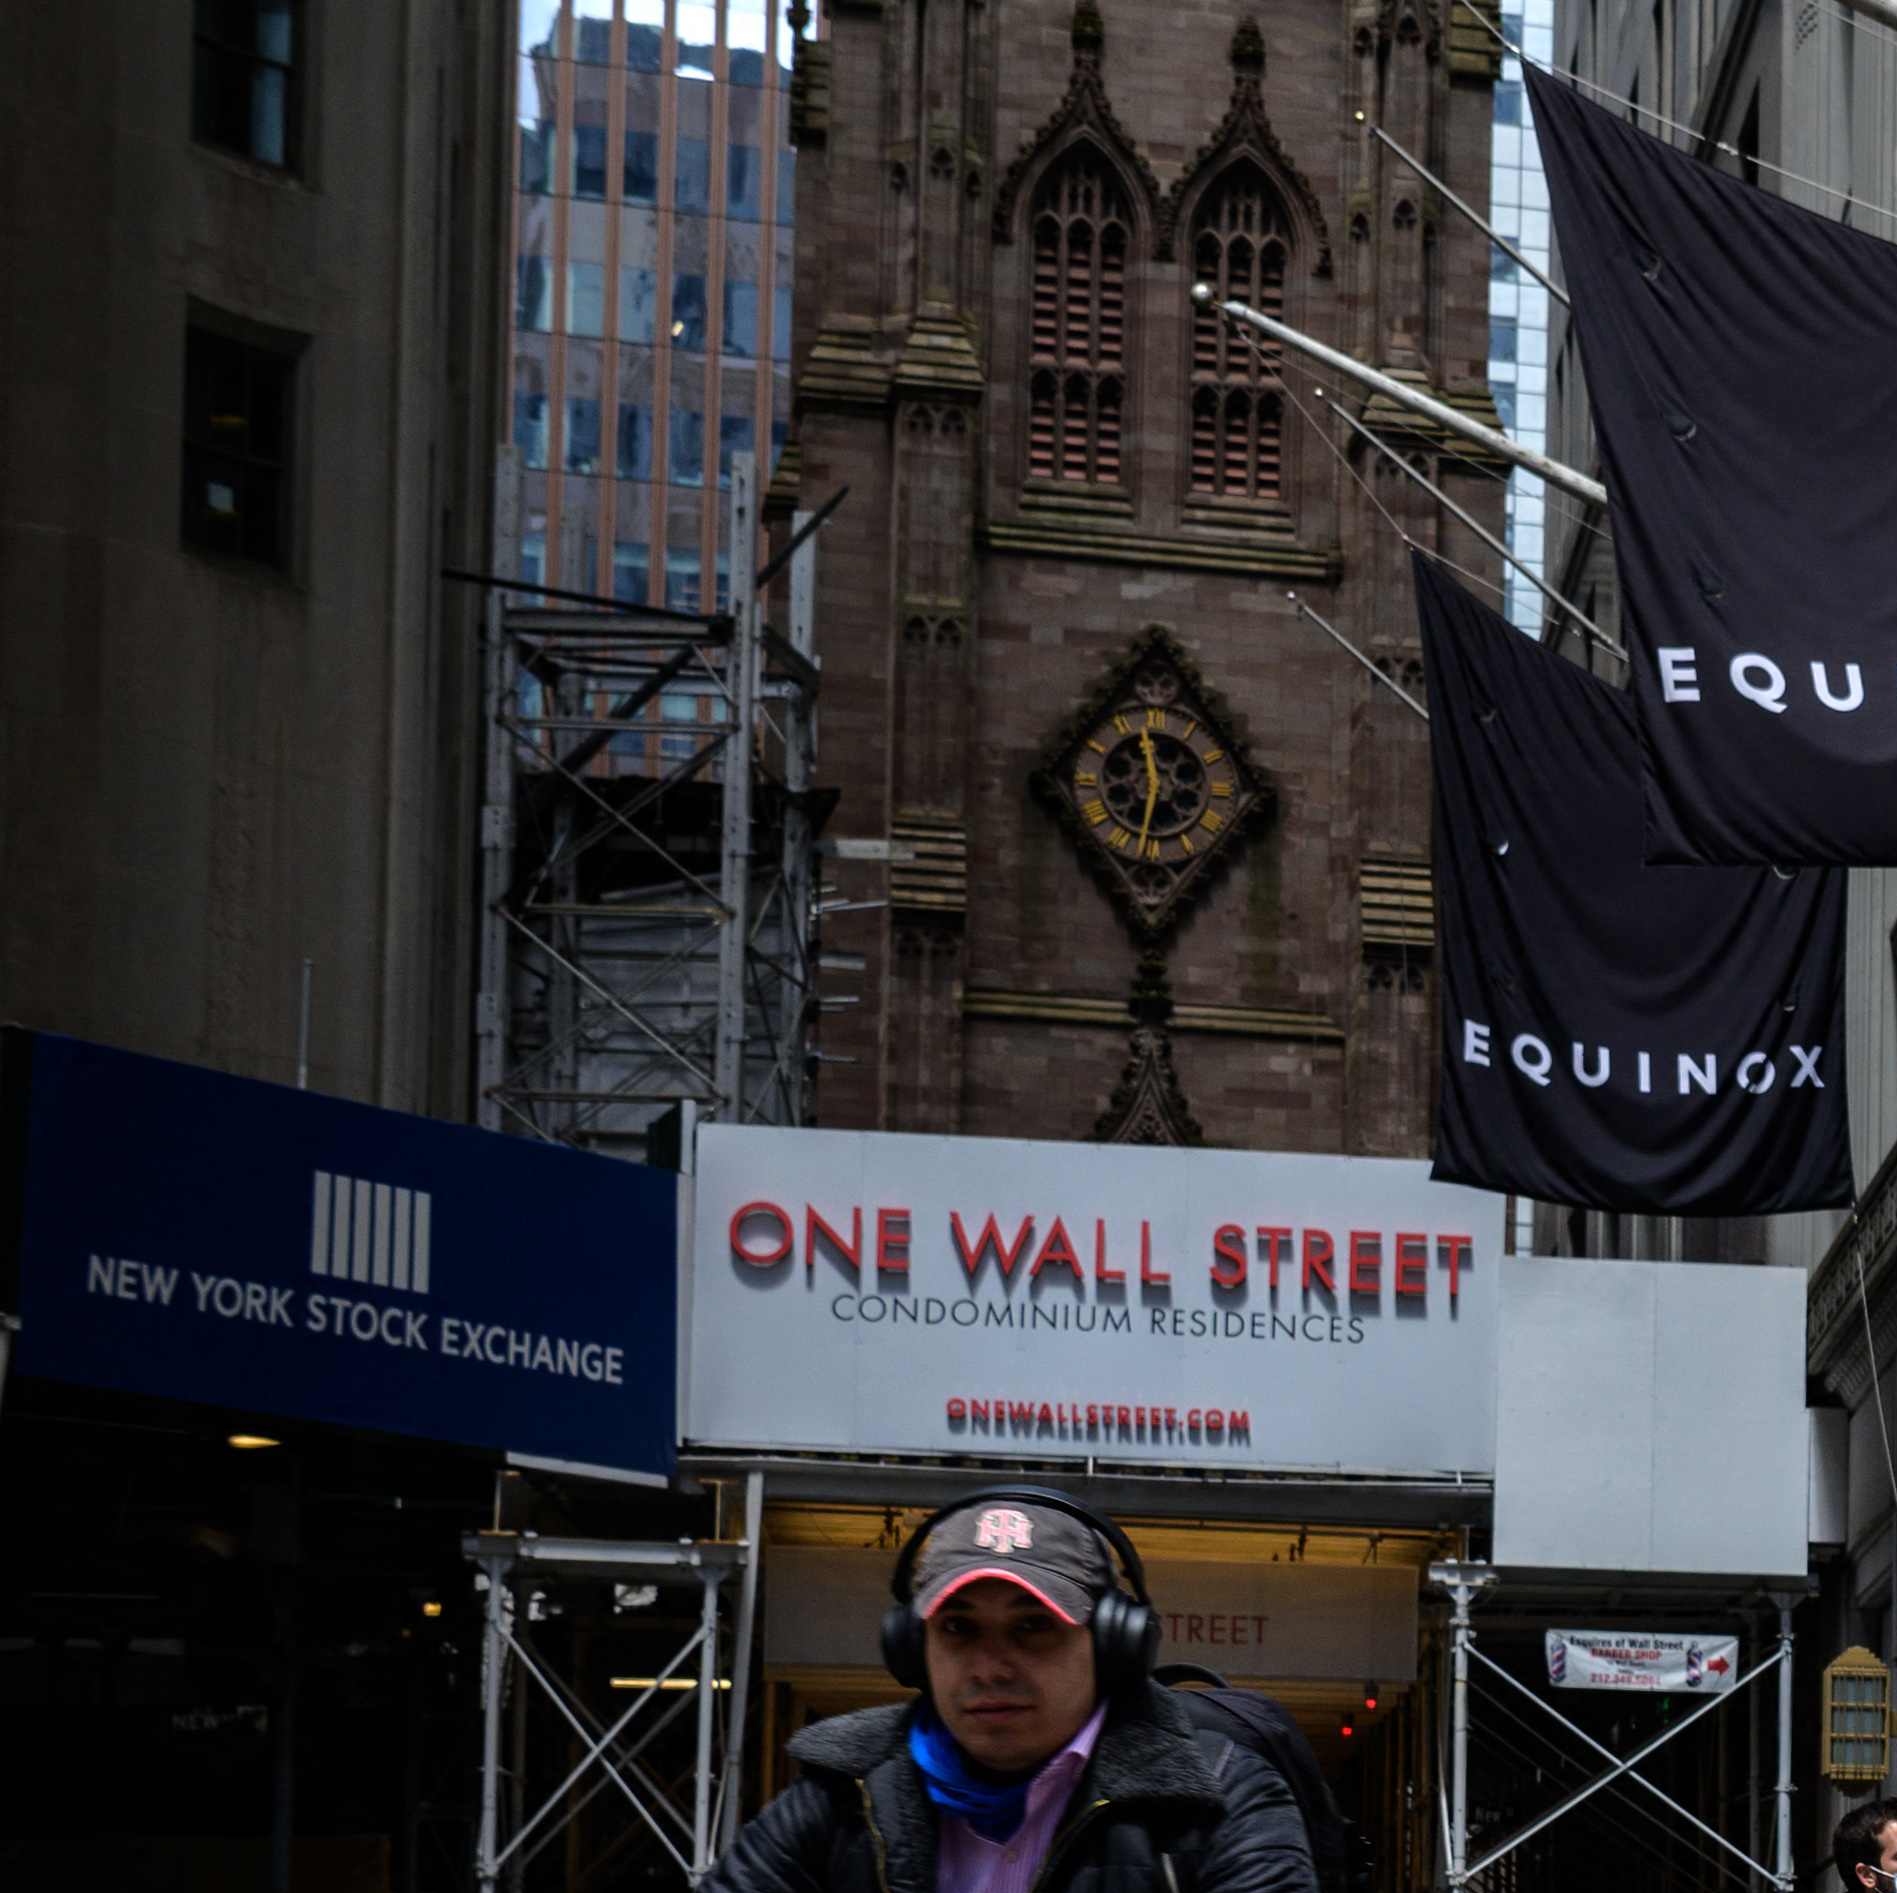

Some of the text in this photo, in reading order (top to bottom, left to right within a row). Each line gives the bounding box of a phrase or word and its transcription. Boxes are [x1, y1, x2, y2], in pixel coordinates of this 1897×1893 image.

[1462, 1019, 1825, 1096] EQUINOX
[729, 1200, 1475, 1297] ONE WALL STREET
[86, 1253, 624, 1385] NEW YORK STOCK EXCHANGE
[831, 1291, 1366, 1345] CONDOMINIUM RESIDENCES
[946, 1395, 1251, 1432] ONEWALLSTREET.COM
[1157, 1612, 1269, 1646] TREET
